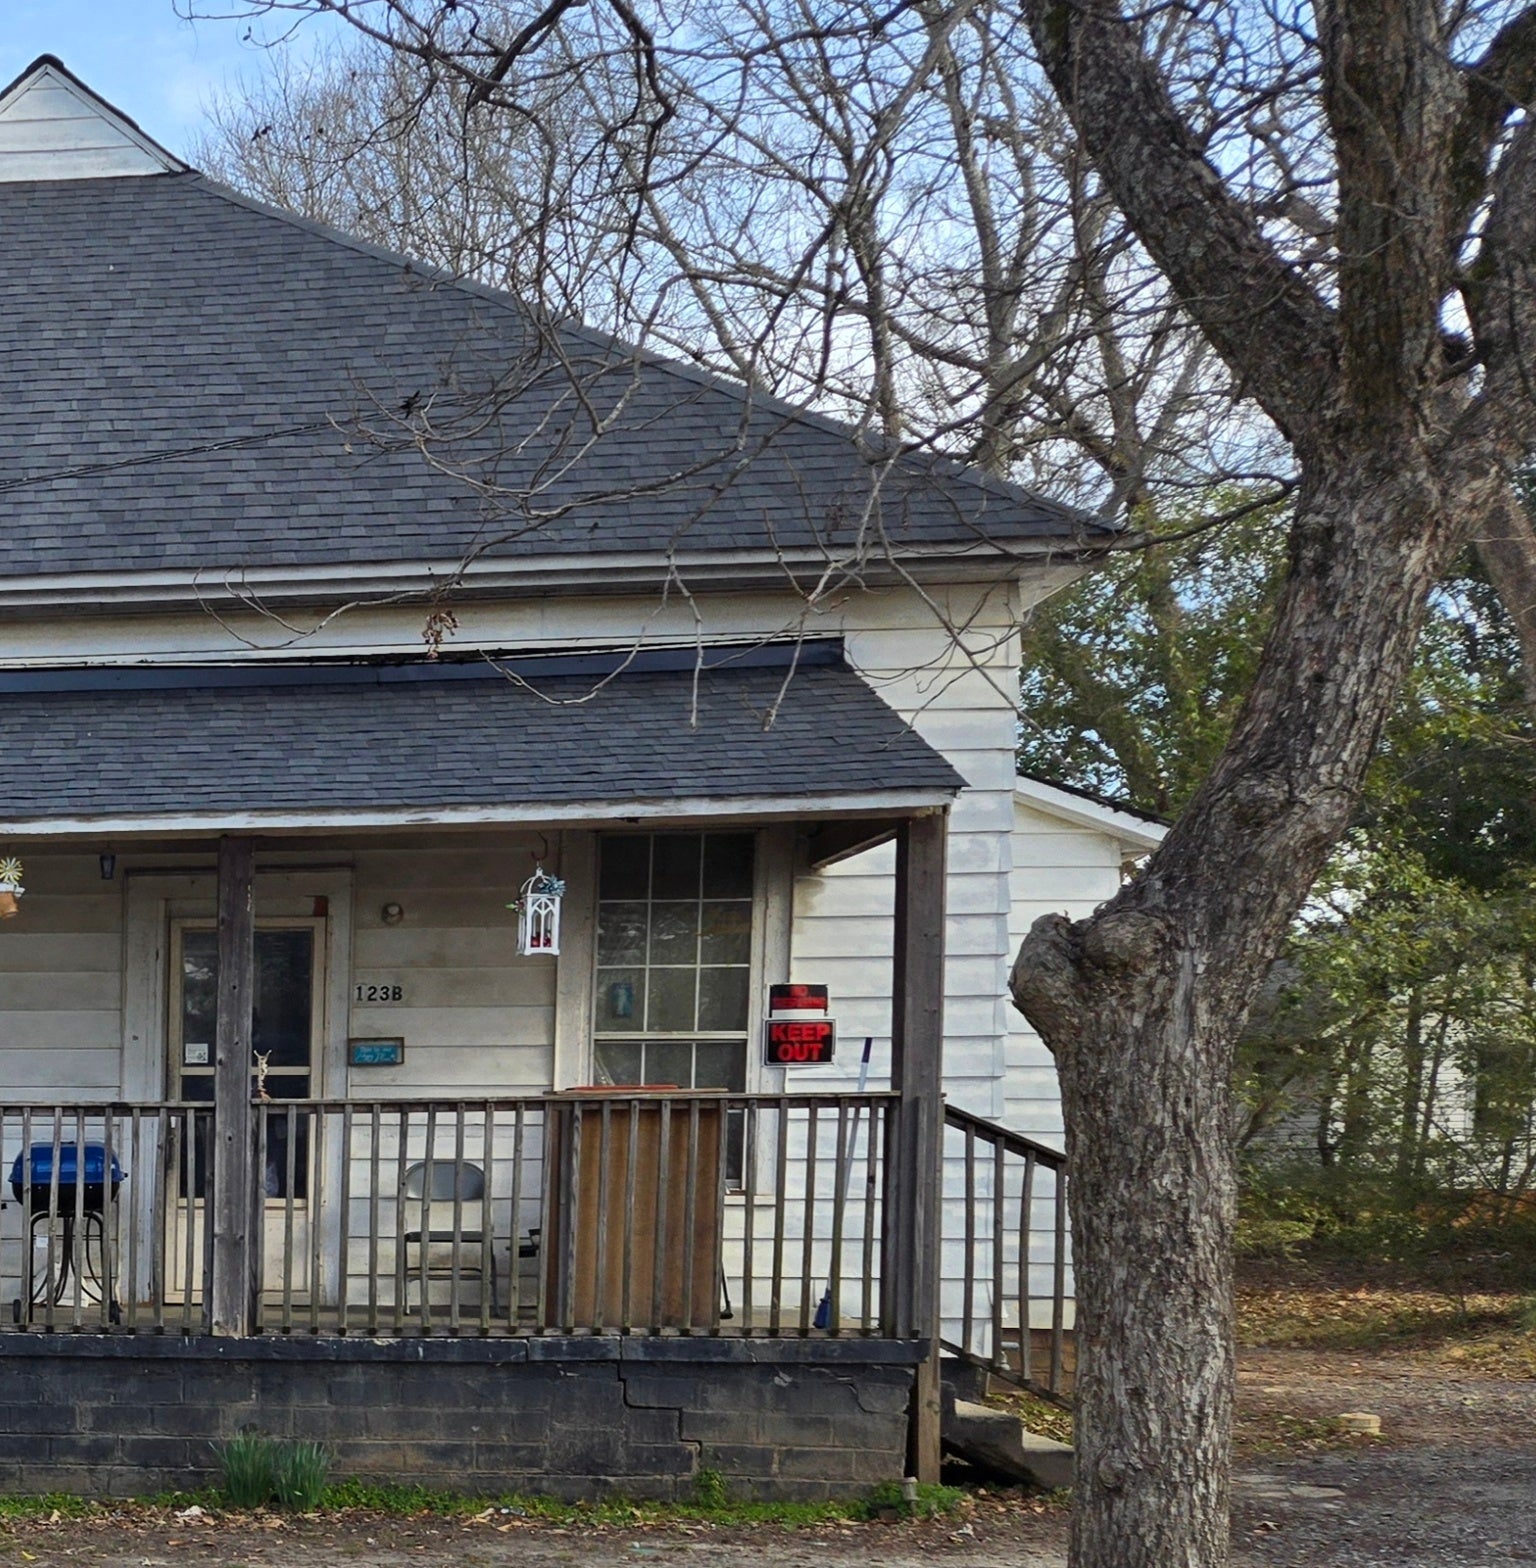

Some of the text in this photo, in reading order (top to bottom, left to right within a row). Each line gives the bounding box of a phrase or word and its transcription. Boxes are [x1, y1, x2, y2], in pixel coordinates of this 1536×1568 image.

[356, 985, 403, 1001] 123B
[770, 1023, 830, 1041] KEEP
[777, 1043, 824, 1061] OUT
